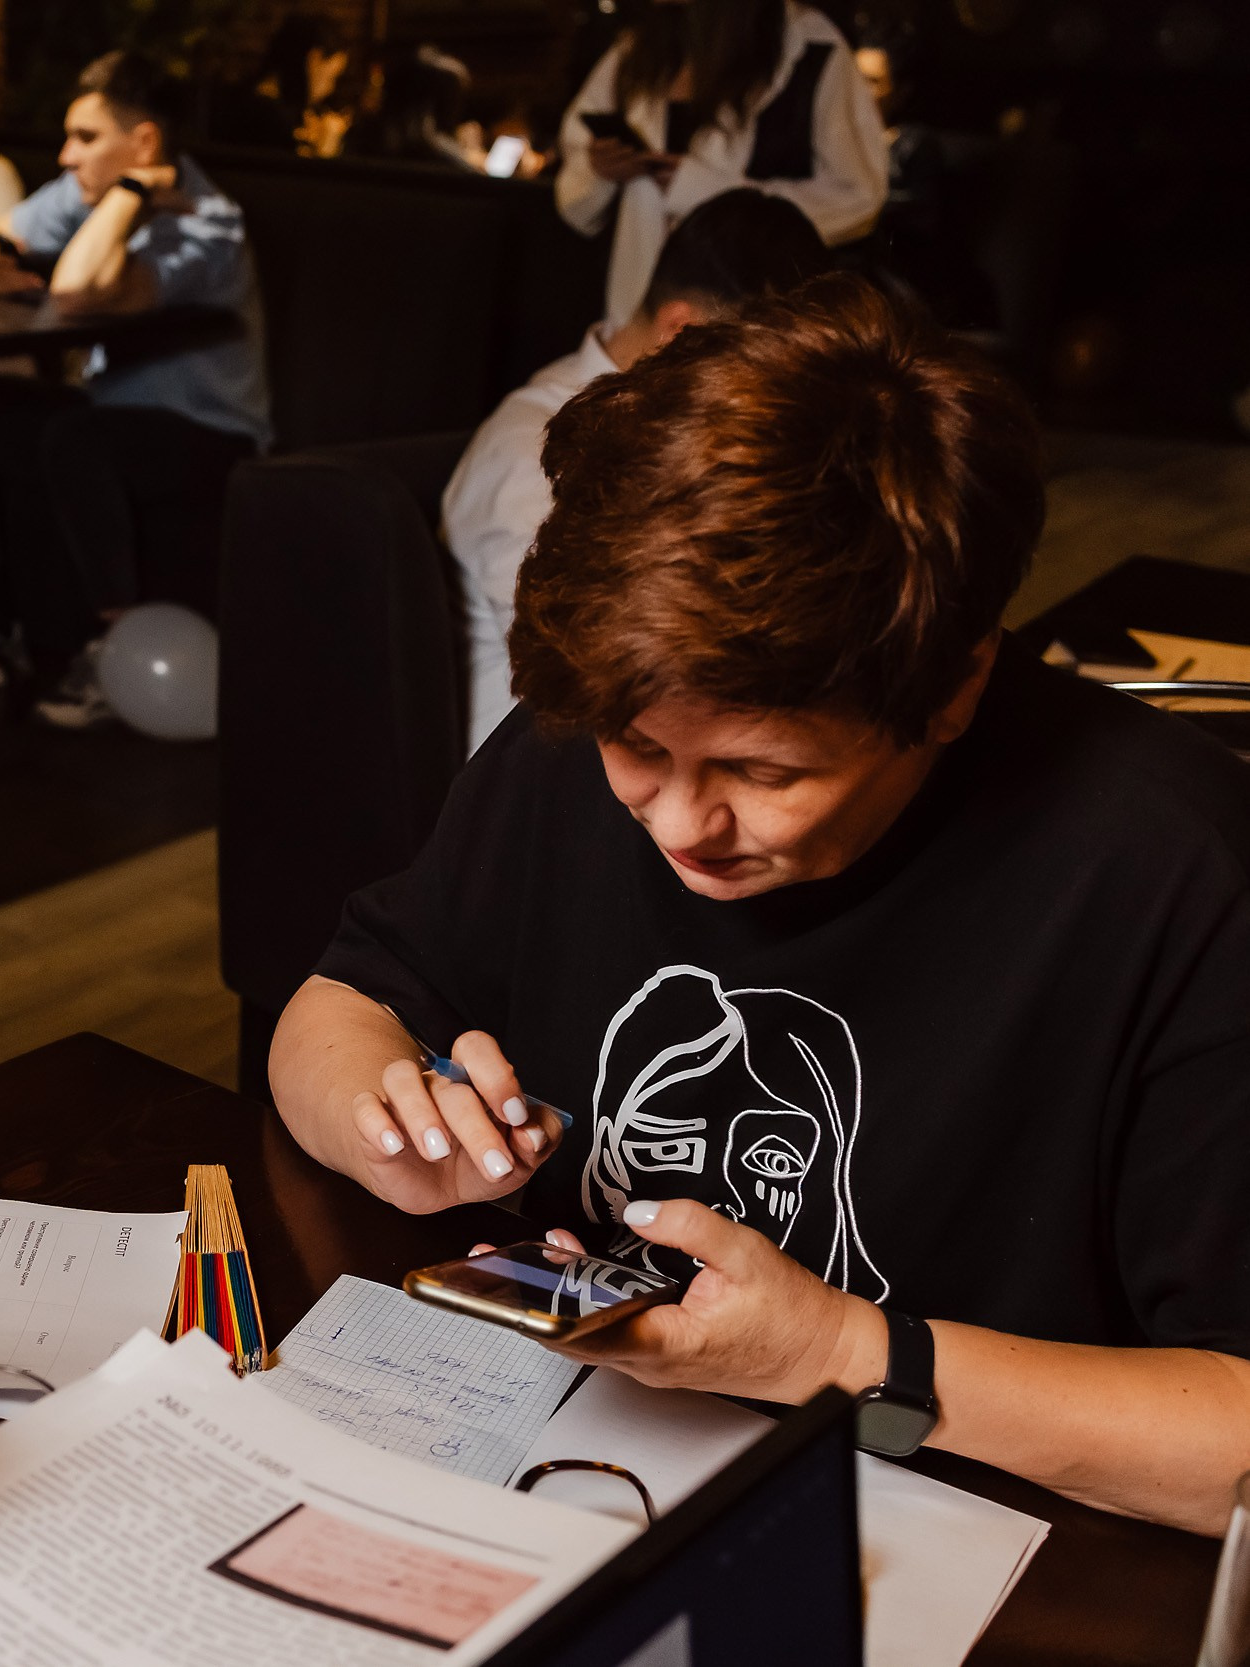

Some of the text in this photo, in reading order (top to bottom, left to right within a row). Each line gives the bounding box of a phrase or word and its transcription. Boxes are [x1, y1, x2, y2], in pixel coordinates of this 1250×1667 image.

[34, 1222, 48, 1248] Преступление
[115, 1226, 132, 1257] DETECTIT
[25, 1249, 37, 1271] совершено
[63, 1254, 77, 1273] Вопрос
